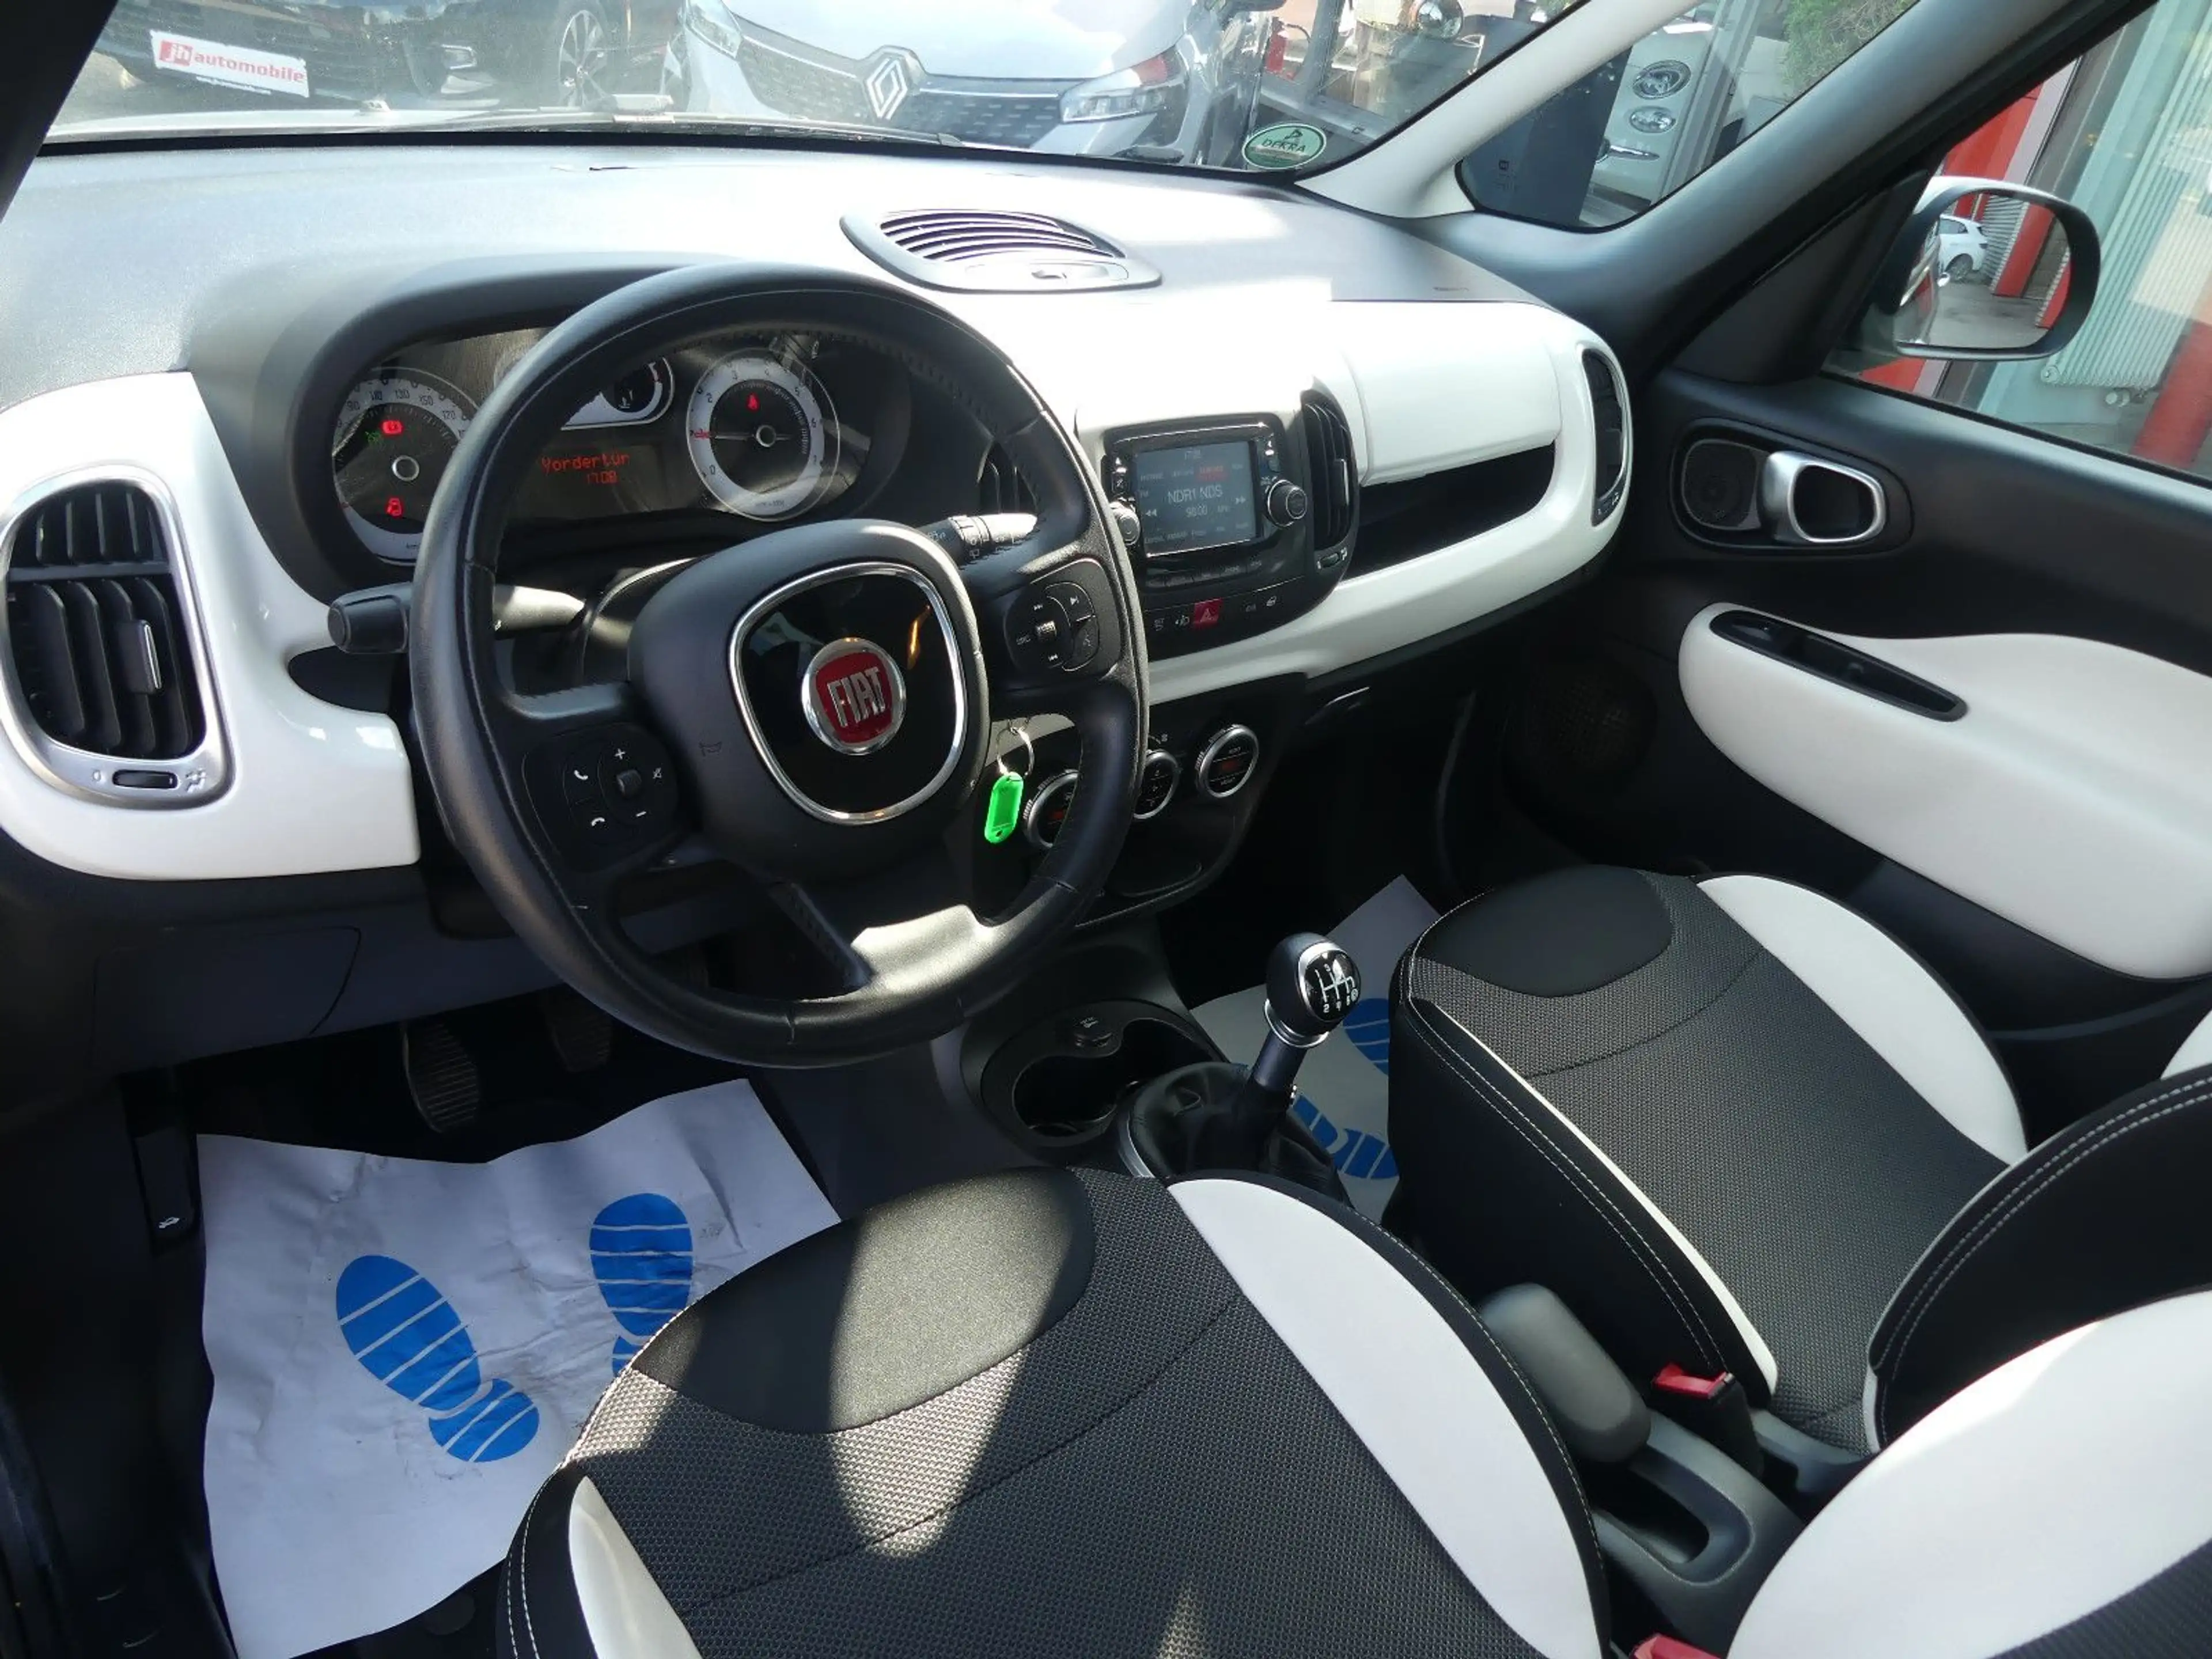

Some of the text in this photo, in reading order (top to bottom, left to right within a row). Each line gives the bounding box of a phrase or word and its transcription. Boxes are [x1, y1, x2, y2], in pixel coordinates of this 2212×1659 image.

[194, 52, 304, 82] automobile
[1262, 138, 1306, 152] DEKRA
[827, 666, 885, 728] FIAT
[1323, 1003, 1330, 1013] 2
